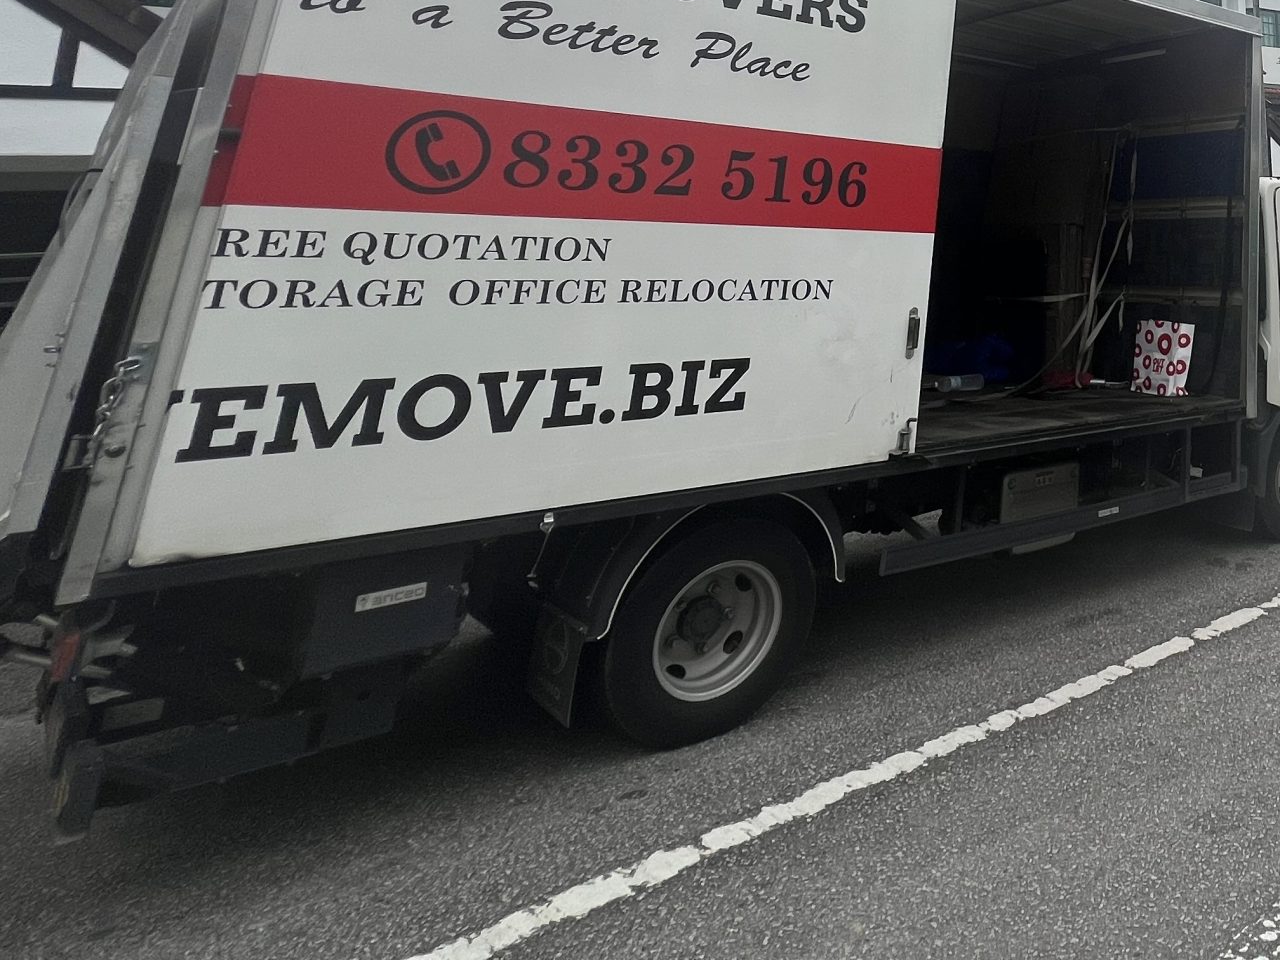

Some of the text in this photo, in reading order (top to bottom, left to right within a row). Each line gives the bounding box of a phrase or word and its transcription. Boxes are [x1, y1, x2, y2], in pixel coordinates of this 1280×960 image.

[412, 0, 454, 29] a
[498, 0, 661, 59] Better
[690, 31, 810, 82] Place
[502, 129, 868, 208] 8332 5196
[210, 227, 613, 266] REE QUOTATION
[201, 278, 834, 310] TORAGE OFFICE RELOCATION
[165, 357, 751, 463] EMOVE.BIZ
